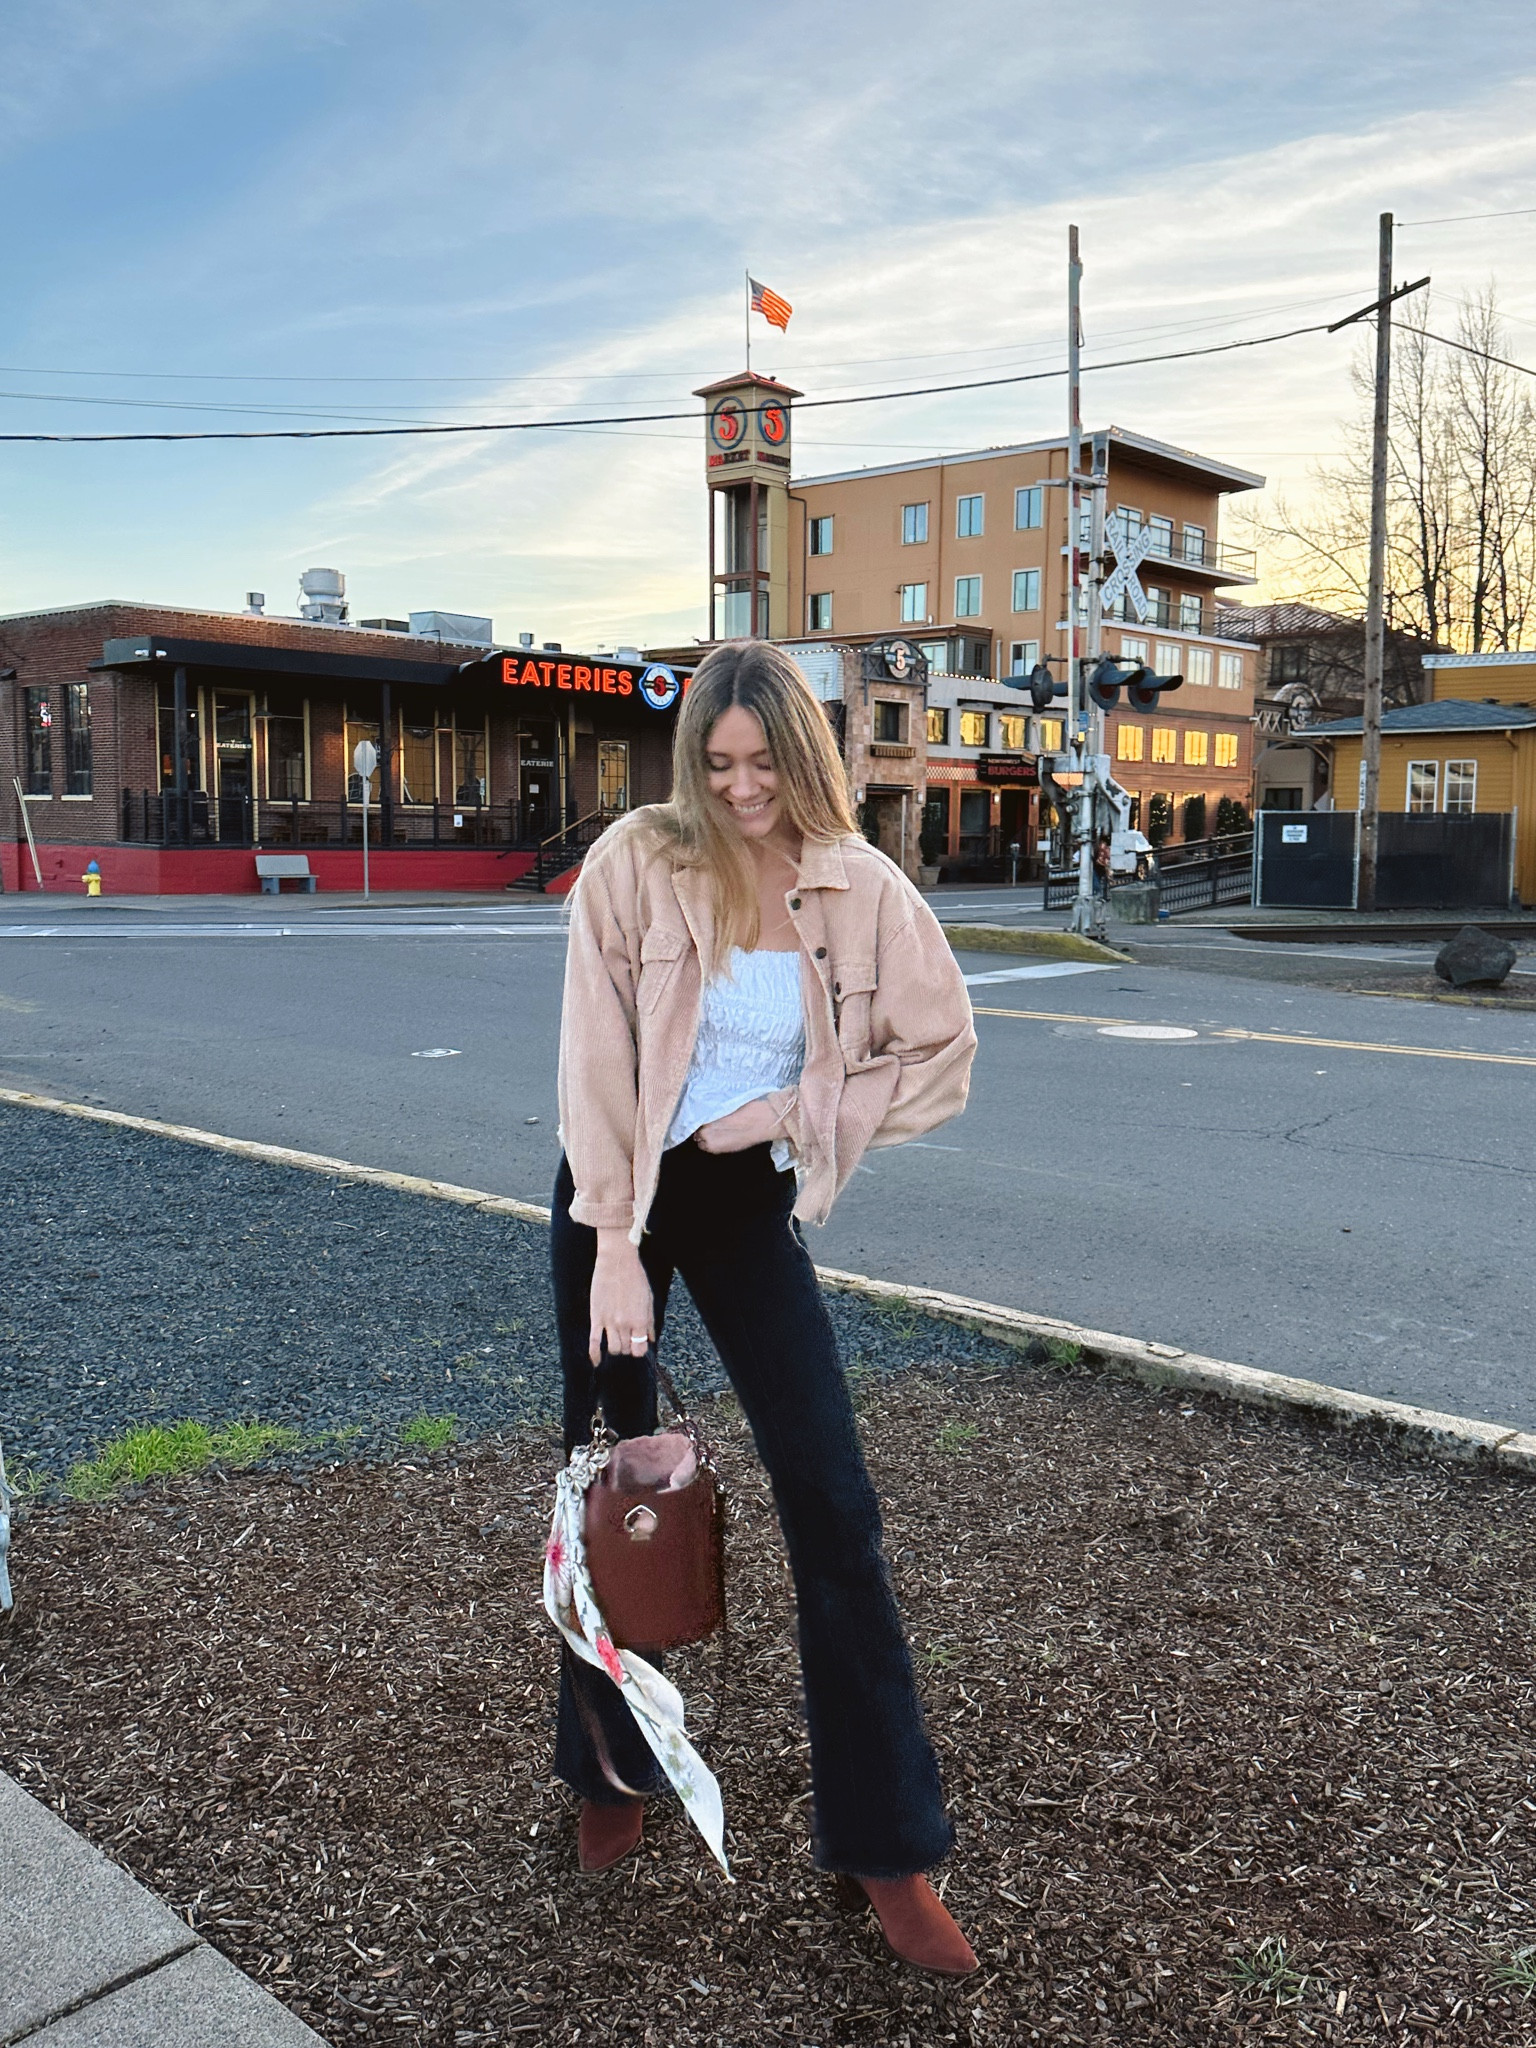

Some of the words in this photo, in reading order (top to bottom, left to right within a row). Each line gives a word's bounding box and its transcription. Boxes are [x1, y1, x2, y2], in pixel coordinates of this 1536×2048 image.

[896, 649, 905, 670] 5
[503, 658, 633, 695] EATERIES
[988, 766, 1036, 776] BURGERS
